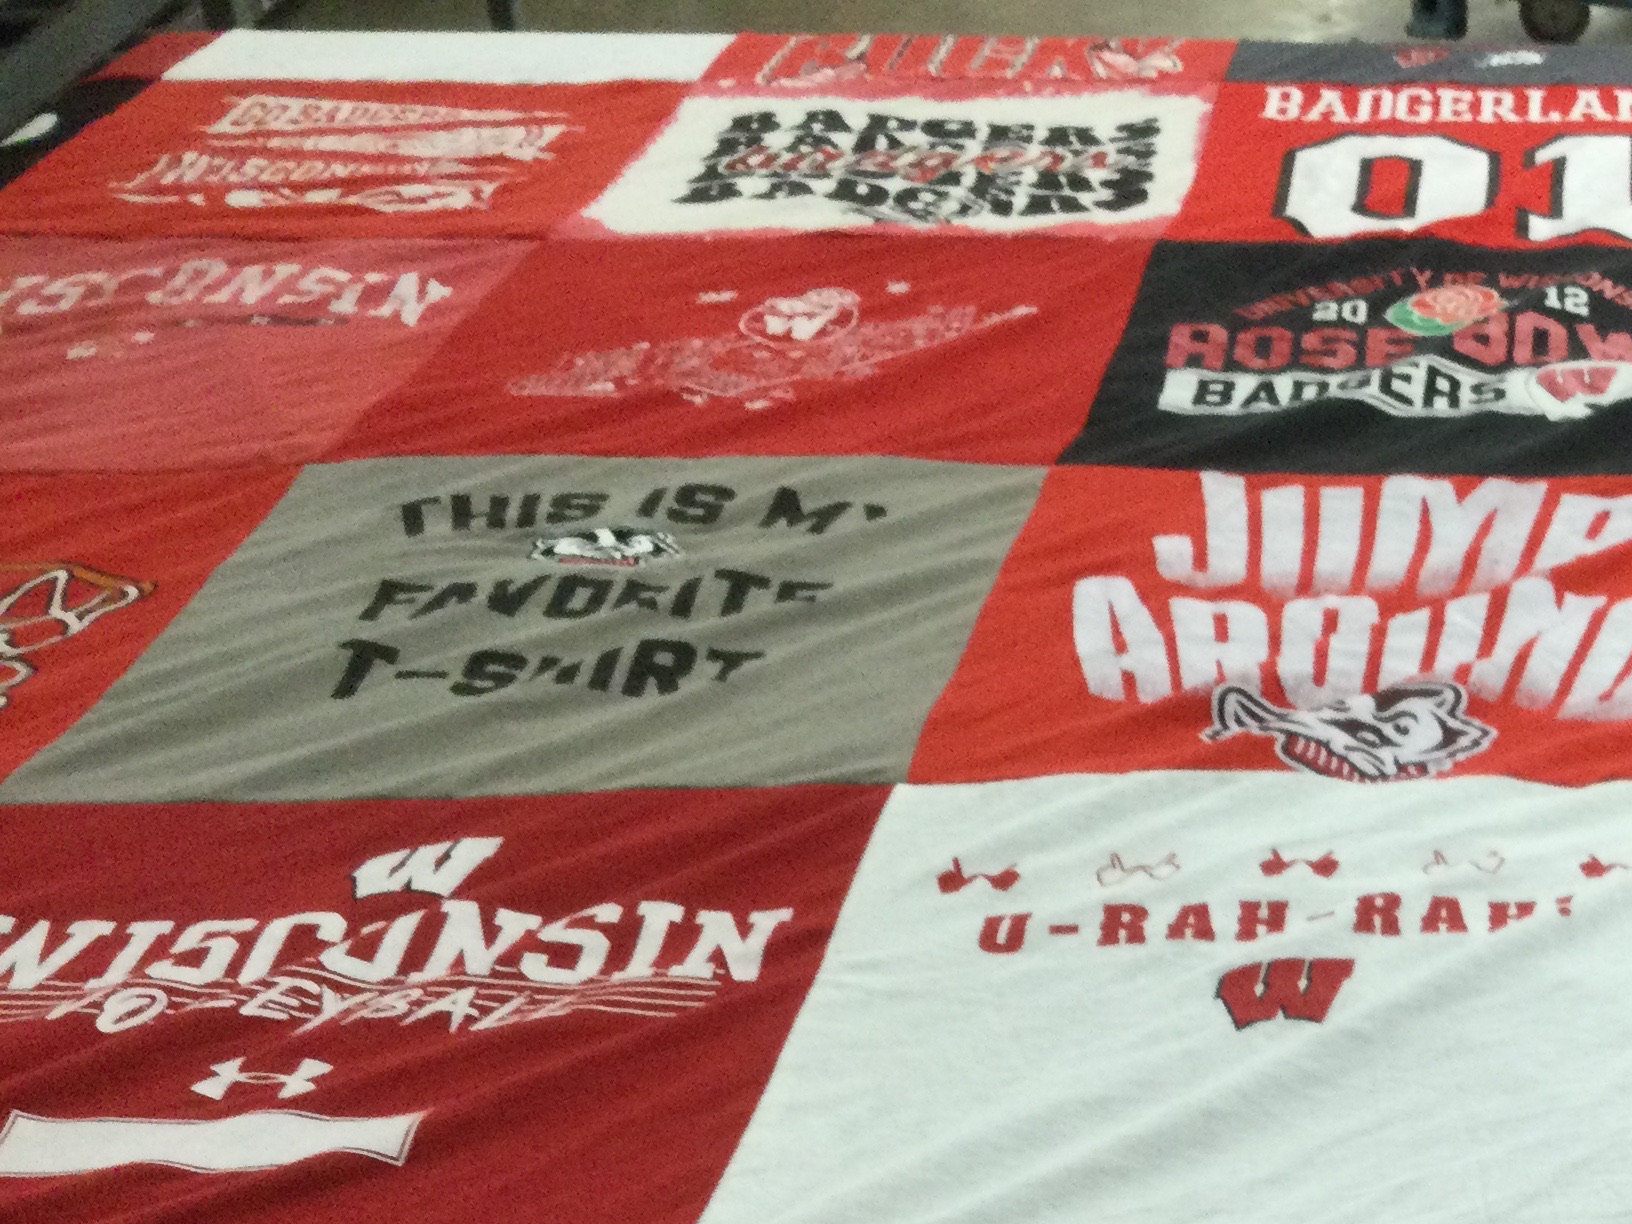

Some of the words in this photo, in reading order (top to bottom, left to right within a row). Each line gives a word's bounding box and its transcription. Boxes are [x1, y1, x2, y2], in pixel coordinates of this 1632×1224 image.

[1311, 300, 1368, 325] 20
[1543, 285, 1590, 317] 12
[1165, 323, 1418, 370] ROSE
[401, 490, 609, 537] THIS
[638, 483, 736, 525] IS
[759, 486, 888, 535] M
[331, 637, 766, 700] T-SIRT
[0, 900, 794, 983] WISCONSIN
